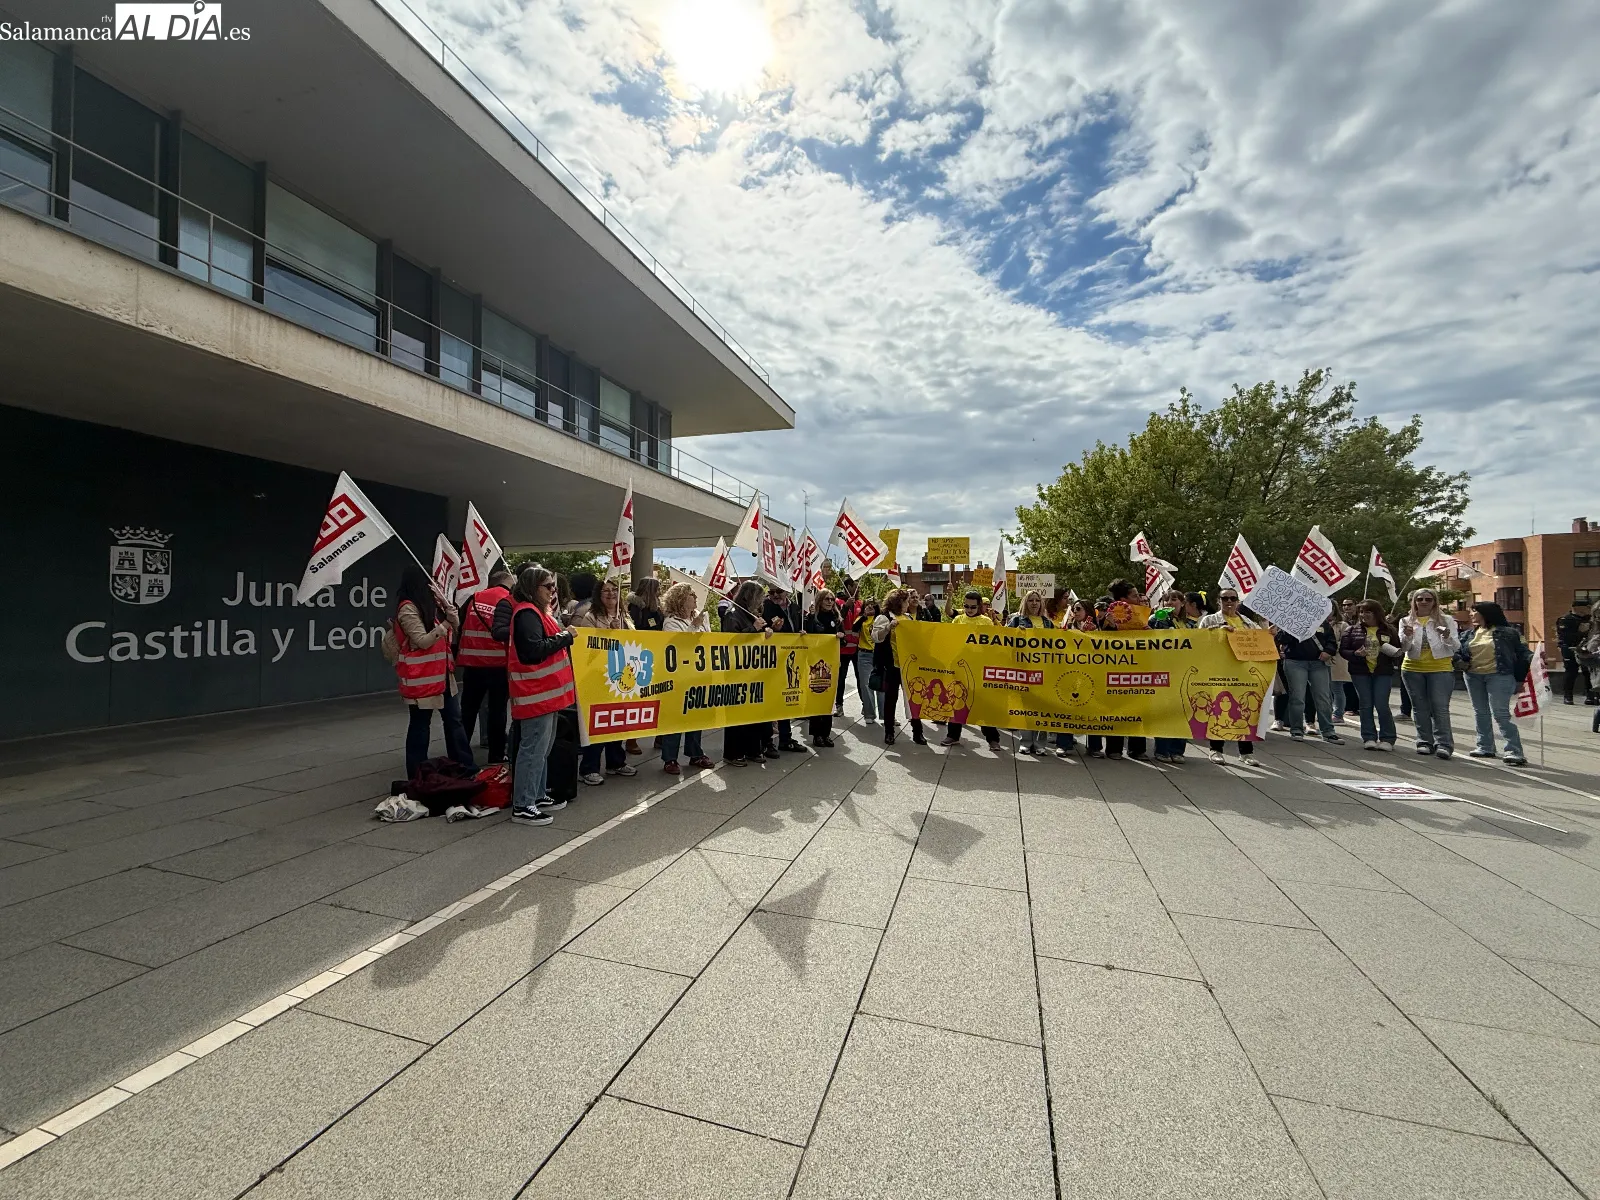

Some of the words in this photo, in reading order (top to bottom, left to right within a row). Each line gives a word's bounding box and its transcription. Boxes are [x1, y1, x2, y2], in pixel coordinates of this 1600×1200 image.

[309, 530, 367, 574] Salamanca
[222, 572, 335, 607] Juna
[349, 577, 387, 607] de
[1267, 580, 1293, 600] CON
[1251, 599, 1277, 619] CON
[66, 619, 256, 663] Castilla
[271, 627, 294, 663] y
[308, 619, 387, 651] León
[587, 636, 620, 651] MALTRATO
[966, 634, 1067, 650] ABANDONO
[1073, 638, 1084, 650] Y
[1091, 638, 1193, 651] VIOLENCIA
[665, 644, 677, 672] 0
[694, 645, 706, 671] 3
[711, 645, 731, 671] EN
[734, 645, 778, 670] LUCHA
[1016, 651, 1138, 666] INSTITUCIONAL
[985, 668, 1027, 682] CCOO
[1109, 674, 1152, 685] CCOO
[640, 680, 674, 698] SOLUCIONES
[983, 682, 1029, 692] enseñanza
[1106, 687, 1156, 695] enseñanza
[683, 683, 748, 714] ¡SOLUCIONES
[750, 681, 764, 704] YA!
[594, 707, 655, 728] CCOO
[1008, 709, 1038, 717] SOMOS
[1063, 722, 1114, 731] EDUCACIÓN
